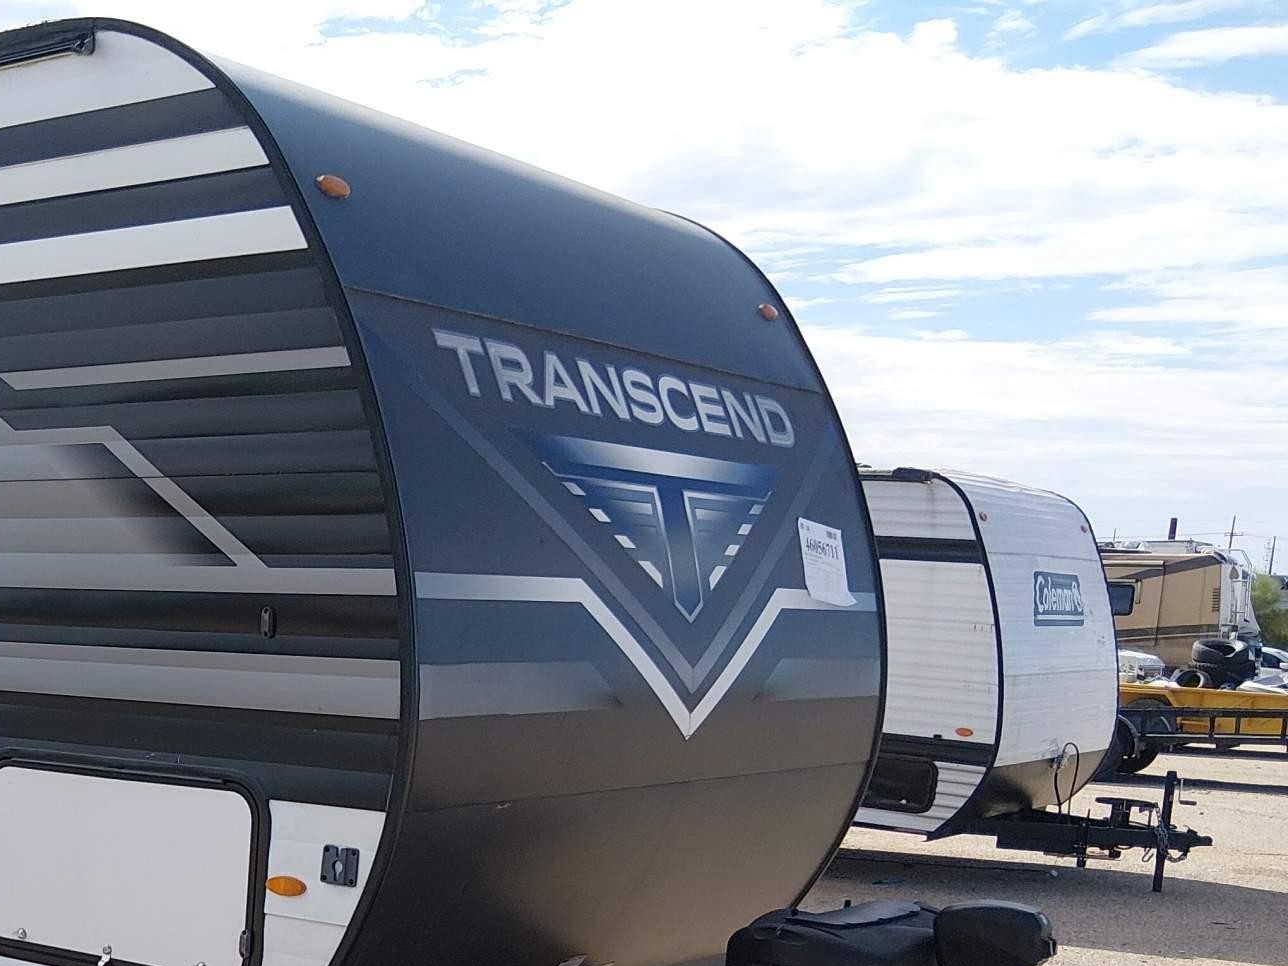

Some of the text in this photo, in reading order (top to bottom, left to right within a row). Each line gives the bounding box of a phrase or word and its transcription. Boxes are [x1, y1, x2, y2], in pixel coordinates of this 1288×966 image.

[431, 328, 795, 449] TRANSCEND
[806, 537, 839, 560] 46056711
[1036, 575, 1075, 613] Coleman
